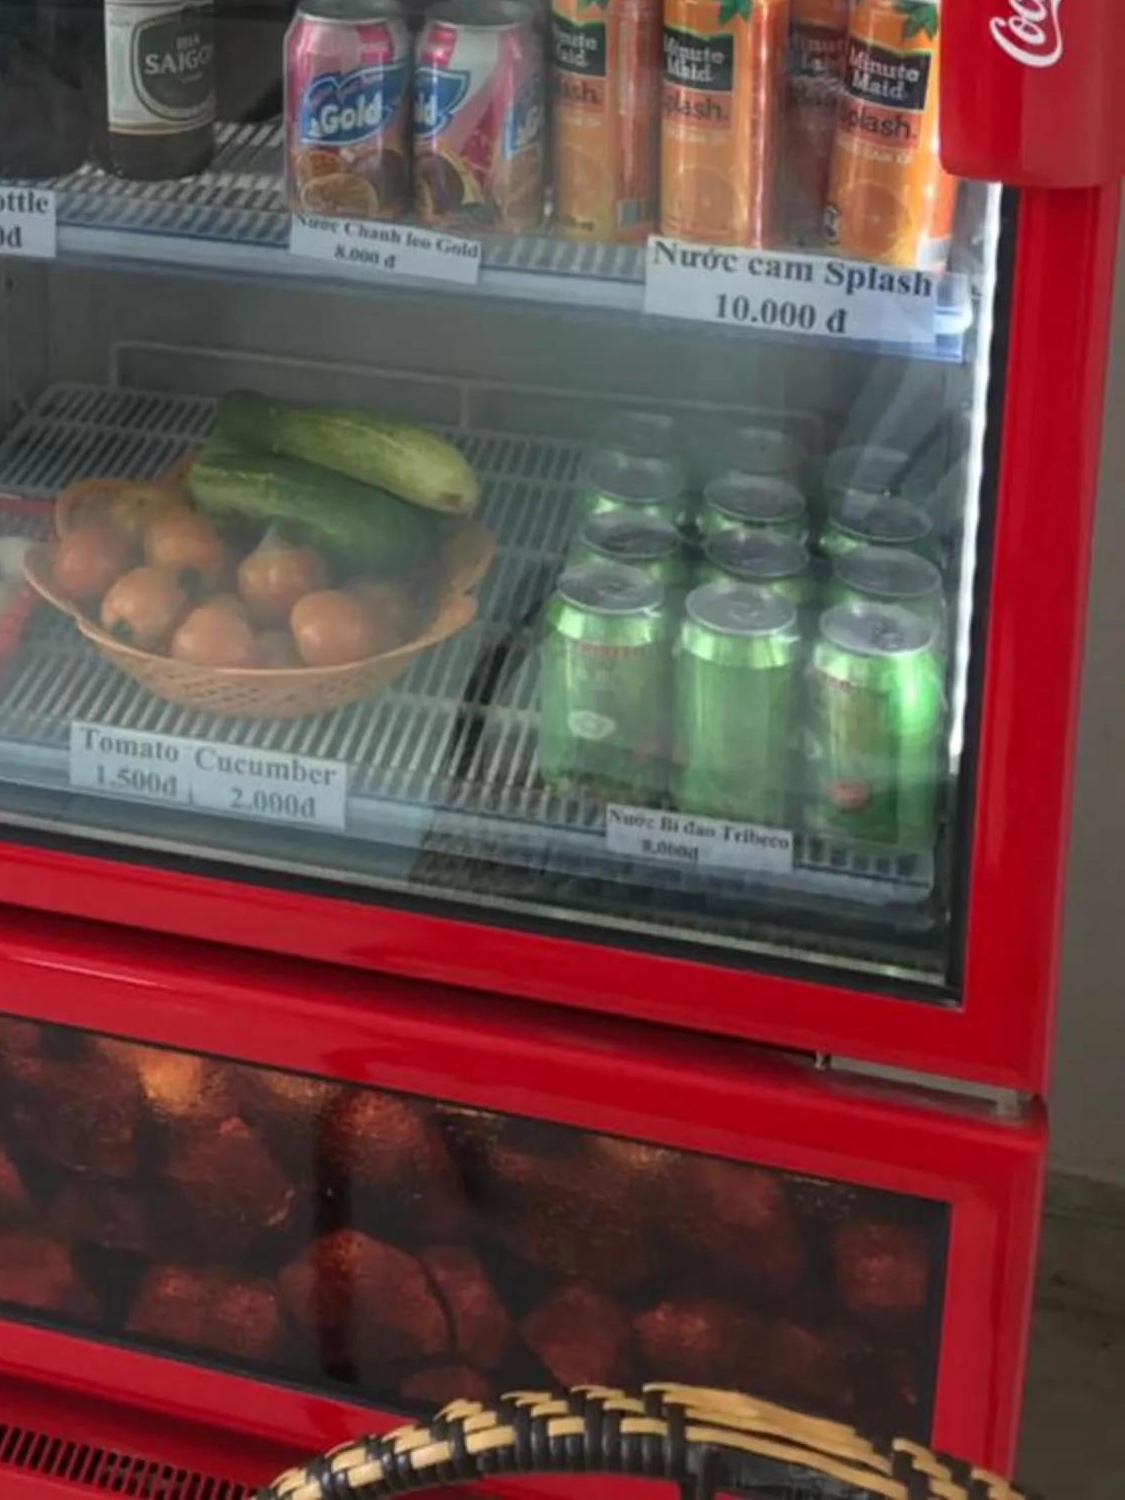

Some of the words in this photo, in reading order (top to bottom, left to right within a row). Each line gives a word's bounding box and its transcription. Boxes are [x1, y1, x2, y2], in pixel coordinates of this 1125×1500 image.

[322, 92, 382, 133] Gold
[654, 241, 739, 274] Nước
[748, 255, 814, 283] cam
[824, 261, 933, 297] Splash
[716, 294, 816, 330] 10.000
[80, 726, 179, 763] Tomato
[194, 746, 338, 787] Cucumber
